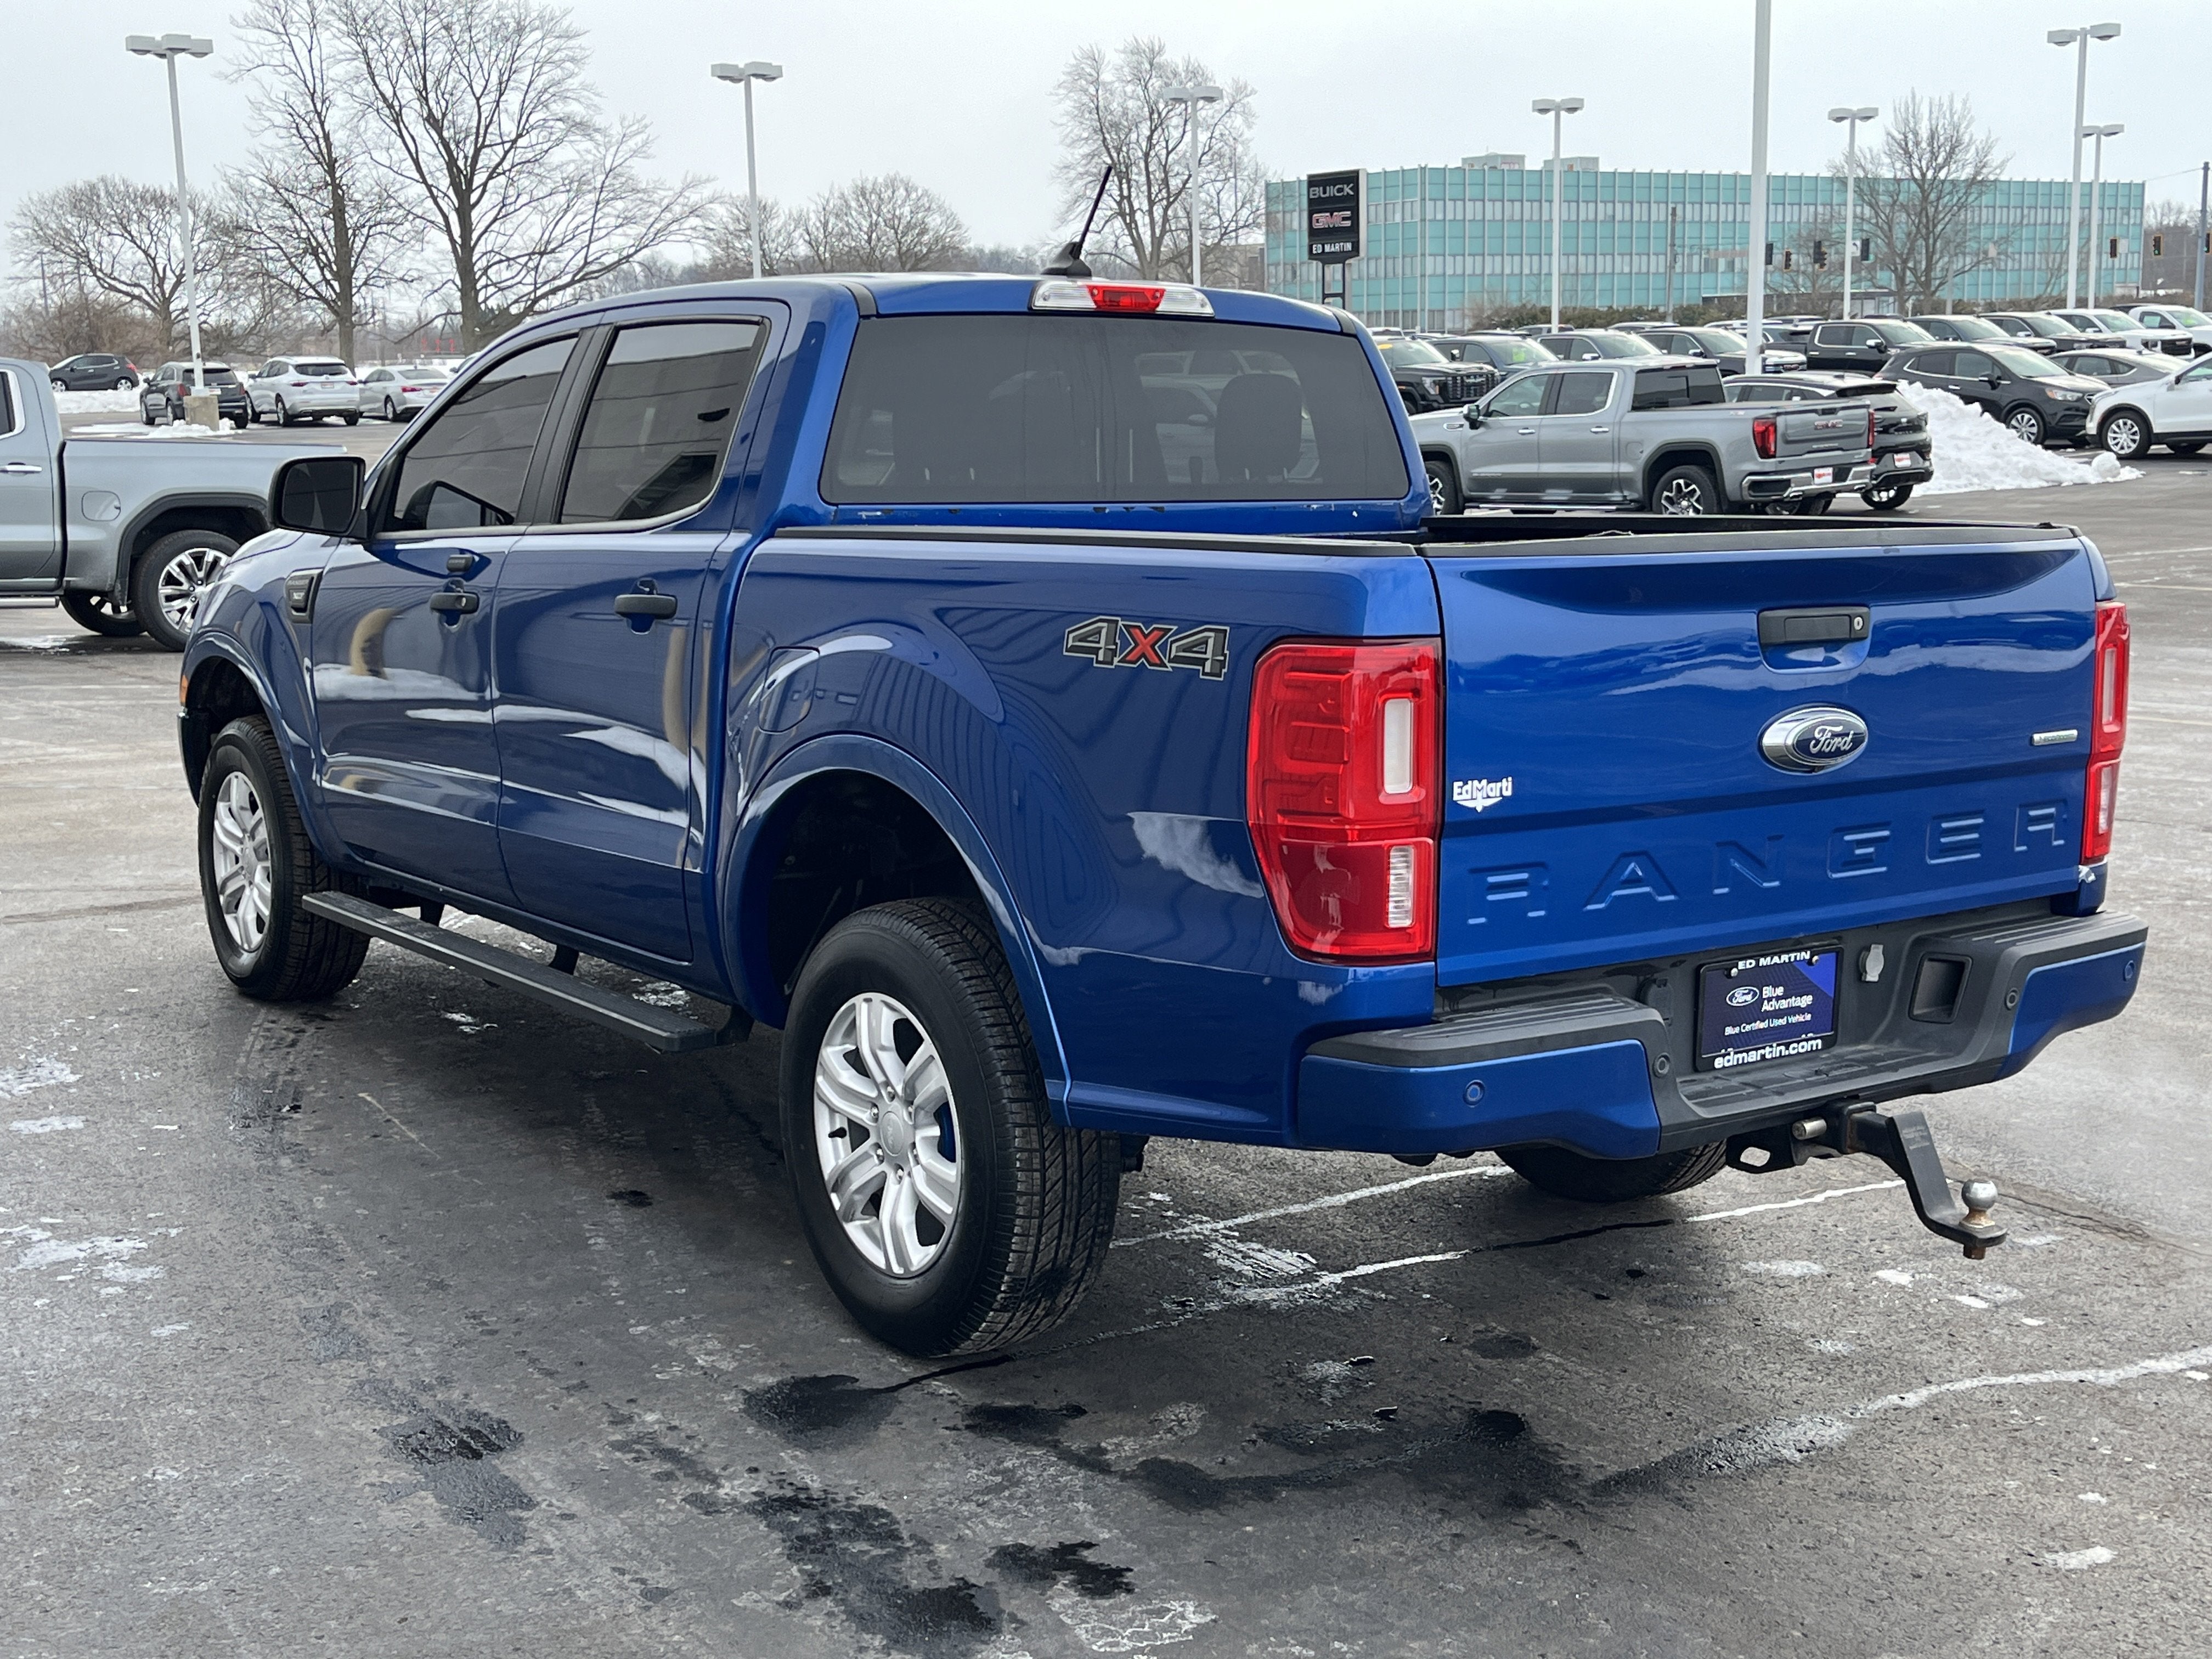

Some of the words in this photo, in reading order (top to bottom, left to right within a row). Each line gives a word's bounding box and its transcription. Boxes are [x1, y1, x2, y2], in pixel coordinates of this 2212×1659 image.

[1310, 183, 1354, 199] BUICK
[1312, 211, 1351, 229] GMC
[1312, 244, 1322, 254] ED
[1324, 242, 1352, 253] MARTIN
[1810, 725, 1854, 753] Ford
[1467, 799, 2067, 924] RANGER
[1738, 959, 1756, 970] ED
[1759, 951, 1810, 967] MARTIN
[1732, 989, 1754, 1003] Ford
[1762, 985, 1784, 998] Blue
[1761, 995, 1813, 1012] Advantage
[1724, 1025, 1740, 1036] Blue
[1769, 1016, 1787, 1027] Used
[1788, 1012, 1812, 1023] Vehicle
[1714, 1039, 1822, 1069] edmartin.com
